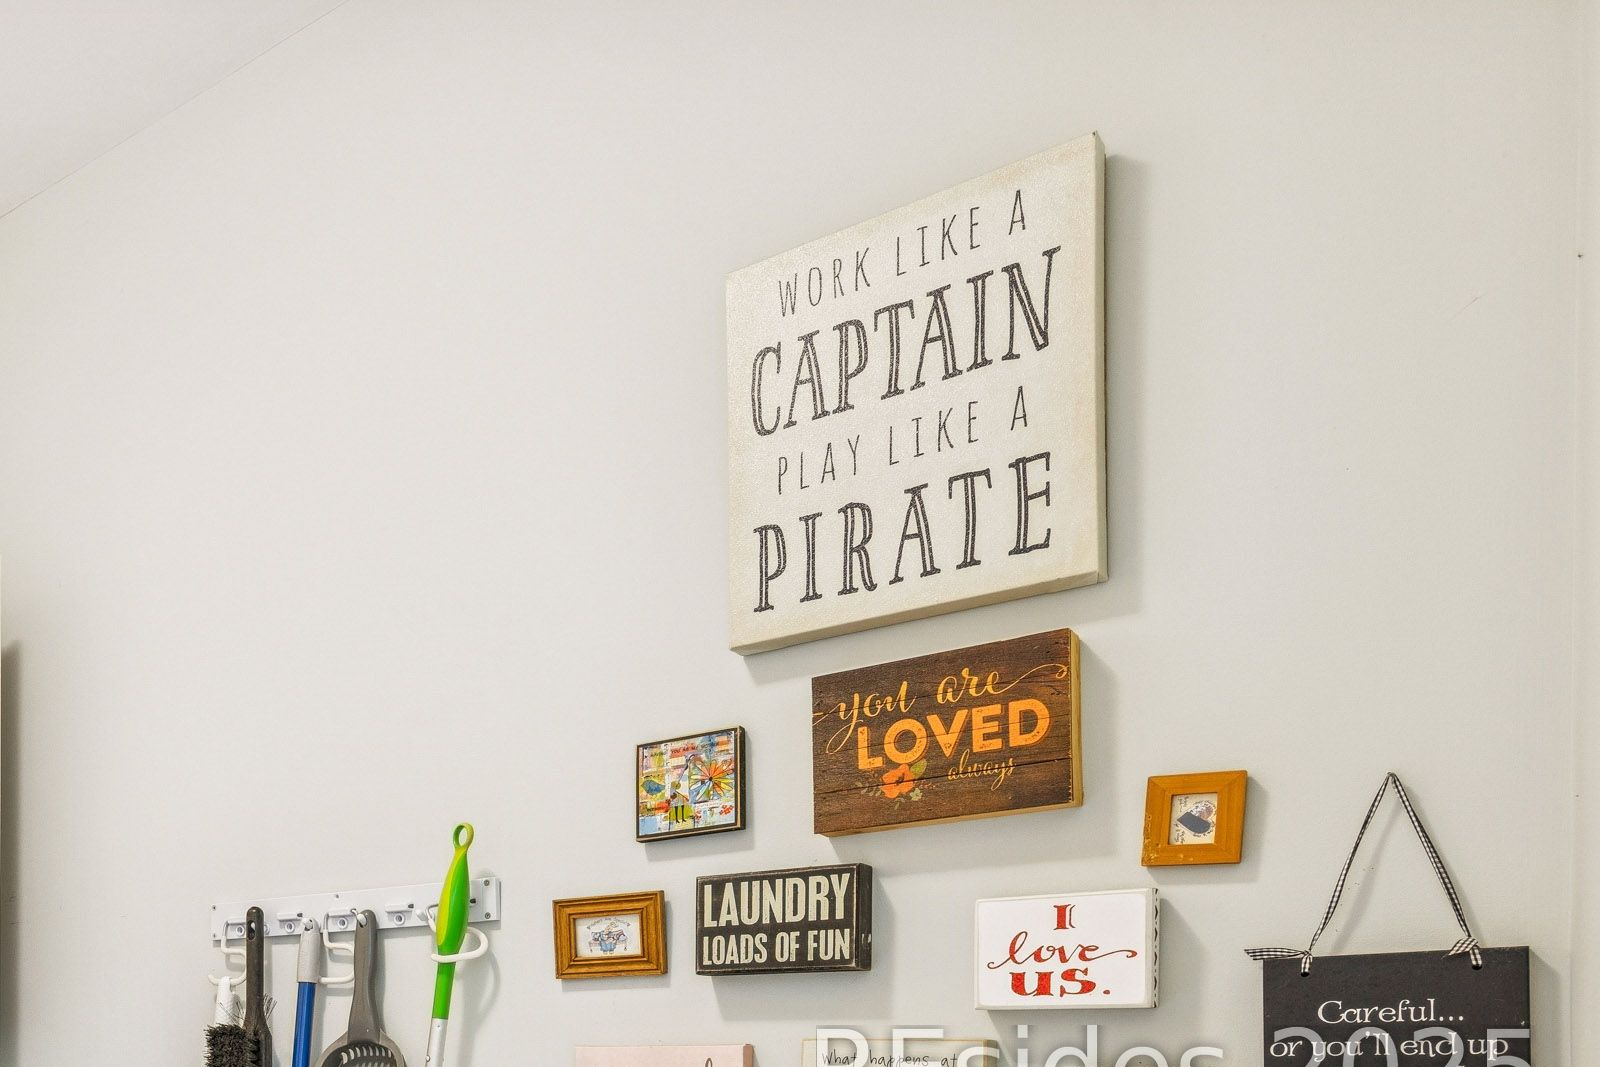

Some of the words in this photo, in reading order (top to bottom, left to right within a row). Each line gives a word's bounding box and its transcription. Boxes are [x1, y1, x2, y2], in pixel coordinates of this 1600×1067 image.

[778, 247, 870, 317] WORK
[896, 206, 980, 277] LIKE
[1008, 189, 1027, 235] A
[751, 246, 1061, 436] CAPTAIN
[777, 435, 861, 495] PLAY
[889, 400, 979, 466] LIKE
[1010, 385, 1028, 431] A
[753, 451, 1052, 613] PIRATE
[813, 681, 917, 755] you
[857, 699, 1050, 769] LOVED
[948, 749, 1015, 791] always
[704, 873, 850, 928] LAUNDRY
[1053, 904, 1076, 930] I
[703, 932, 767, 965] LOADS
[776, 931, 800, 962] OF
[807, 928, 850, 961] FUN
[987, 931, 1137, 969] love
[1009, 967, 1111, 997] us.
[1317, 998, 1465, 1024] Careful...
[822, 1049, 857, 1067] What
[1269, 1039, 1302, 1057] or
[1311, 1030, 1391, 1062] you'll
[1400, 1032, 1458, 1056] end
[1467, 1038, 1509, 1061] up
